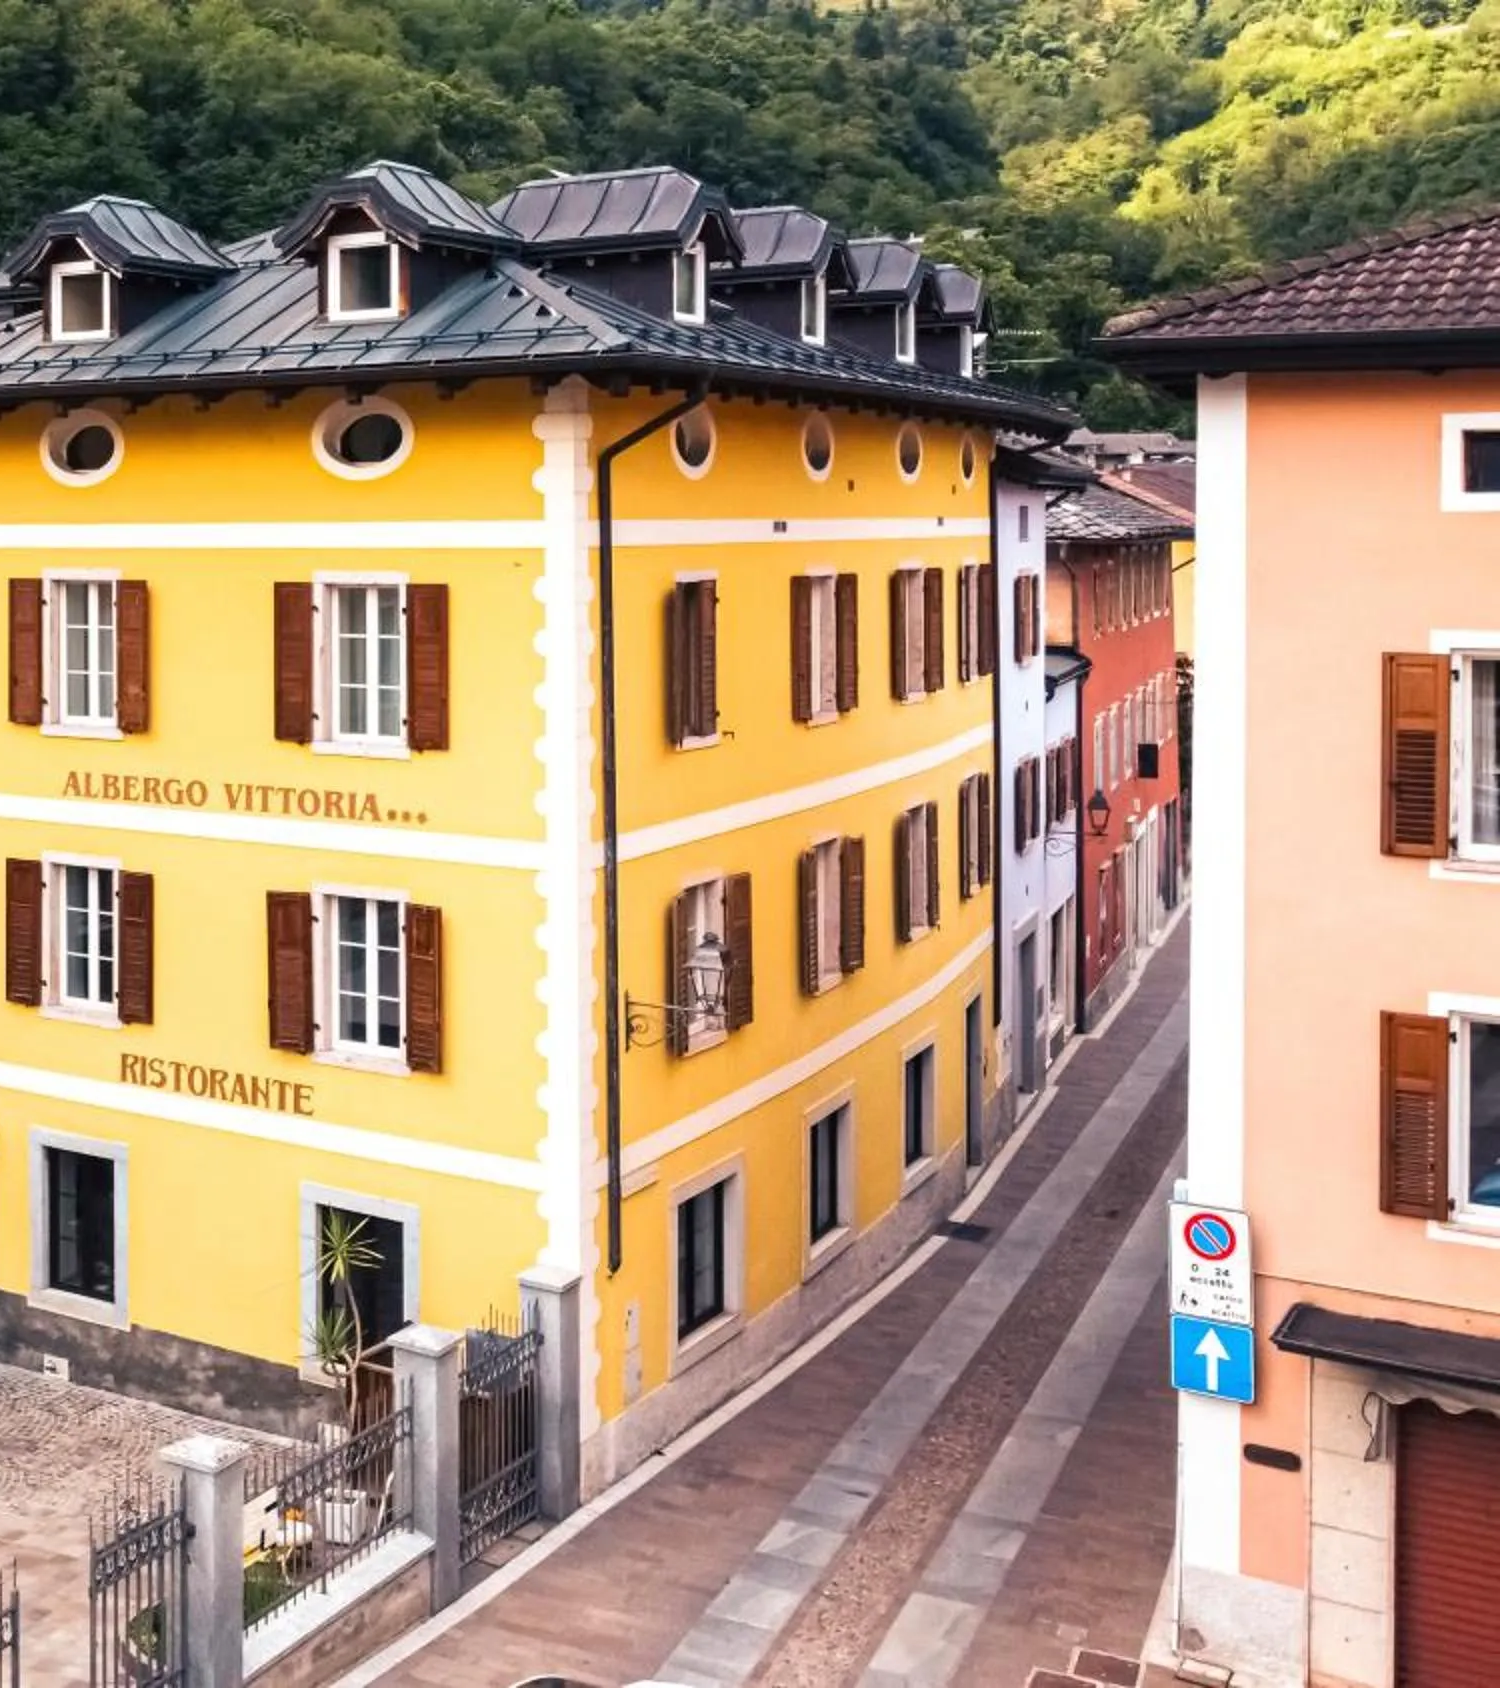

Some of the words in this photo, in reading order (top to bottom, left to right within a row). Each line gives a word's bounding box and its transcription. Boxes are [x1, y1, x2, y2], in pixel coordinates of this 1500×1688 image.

[62, 770, 209, 807] ALBERGO
[120, 1052, 315, 1116] RISTORANTE
[1214, 1267, 1231, 1277] 24
